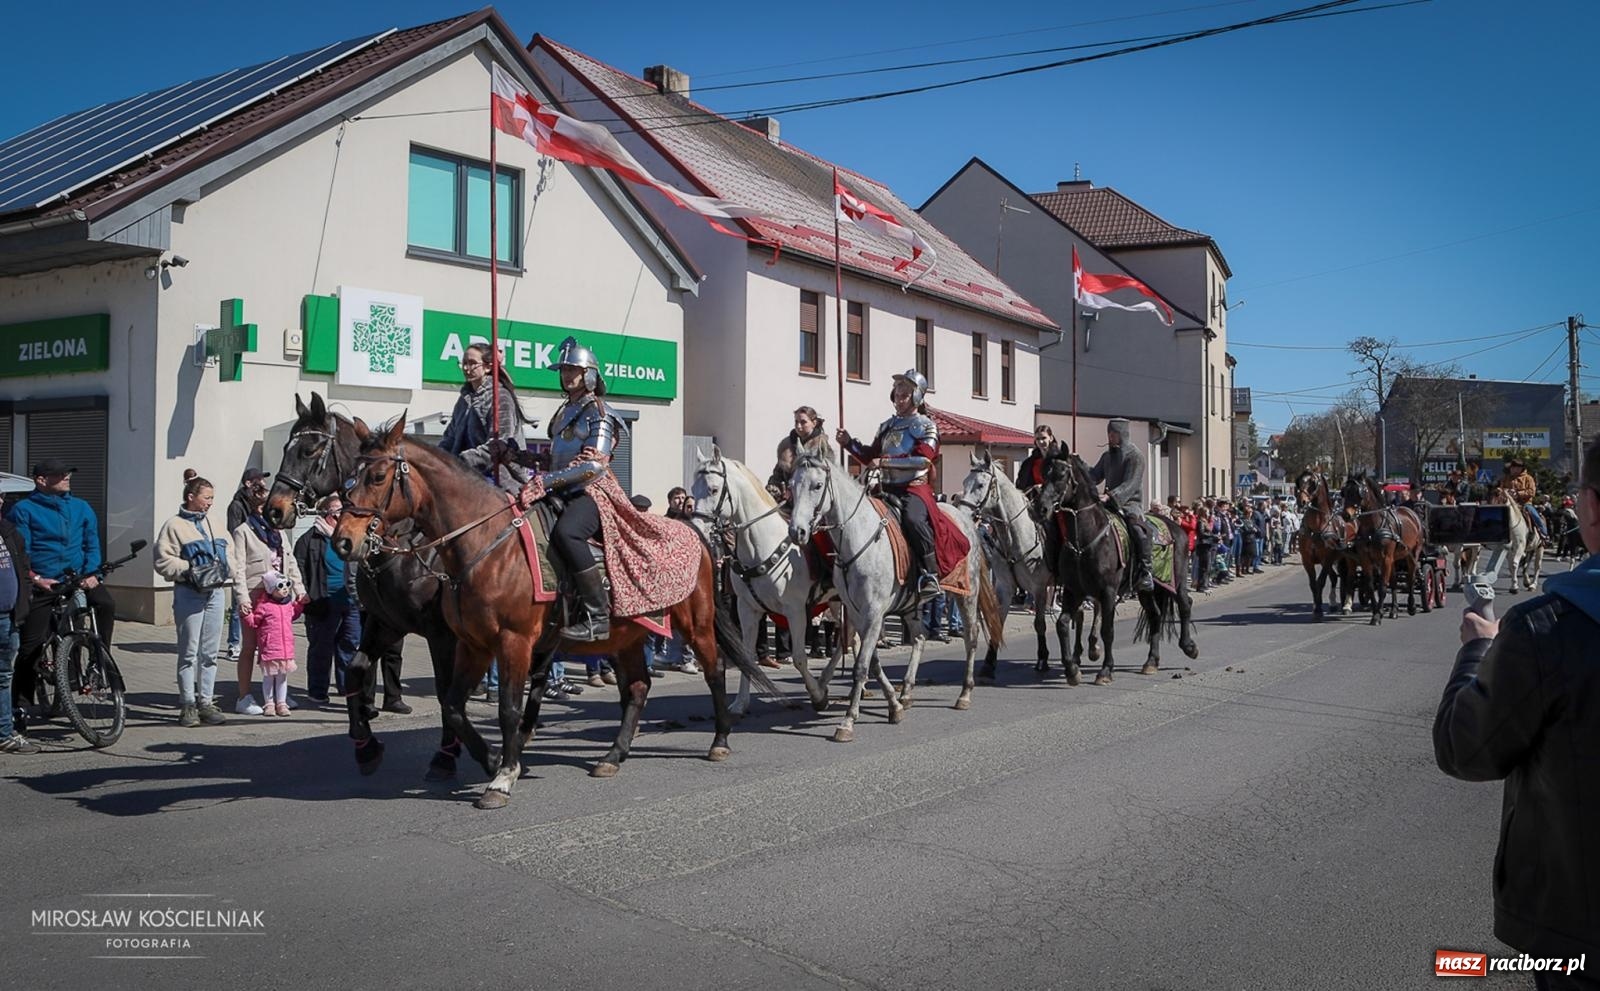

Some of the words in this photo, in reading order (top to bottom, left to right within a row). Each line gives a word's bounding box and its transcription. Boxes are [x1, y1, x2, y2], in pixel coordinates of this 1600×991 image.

[18, 338, 88, 361] ZIELONA
[440, 333, 556, 369] ATEK
[605, 363, 666, 382] ZIELONA
[1422, 461, 1458, 473] PELLET
